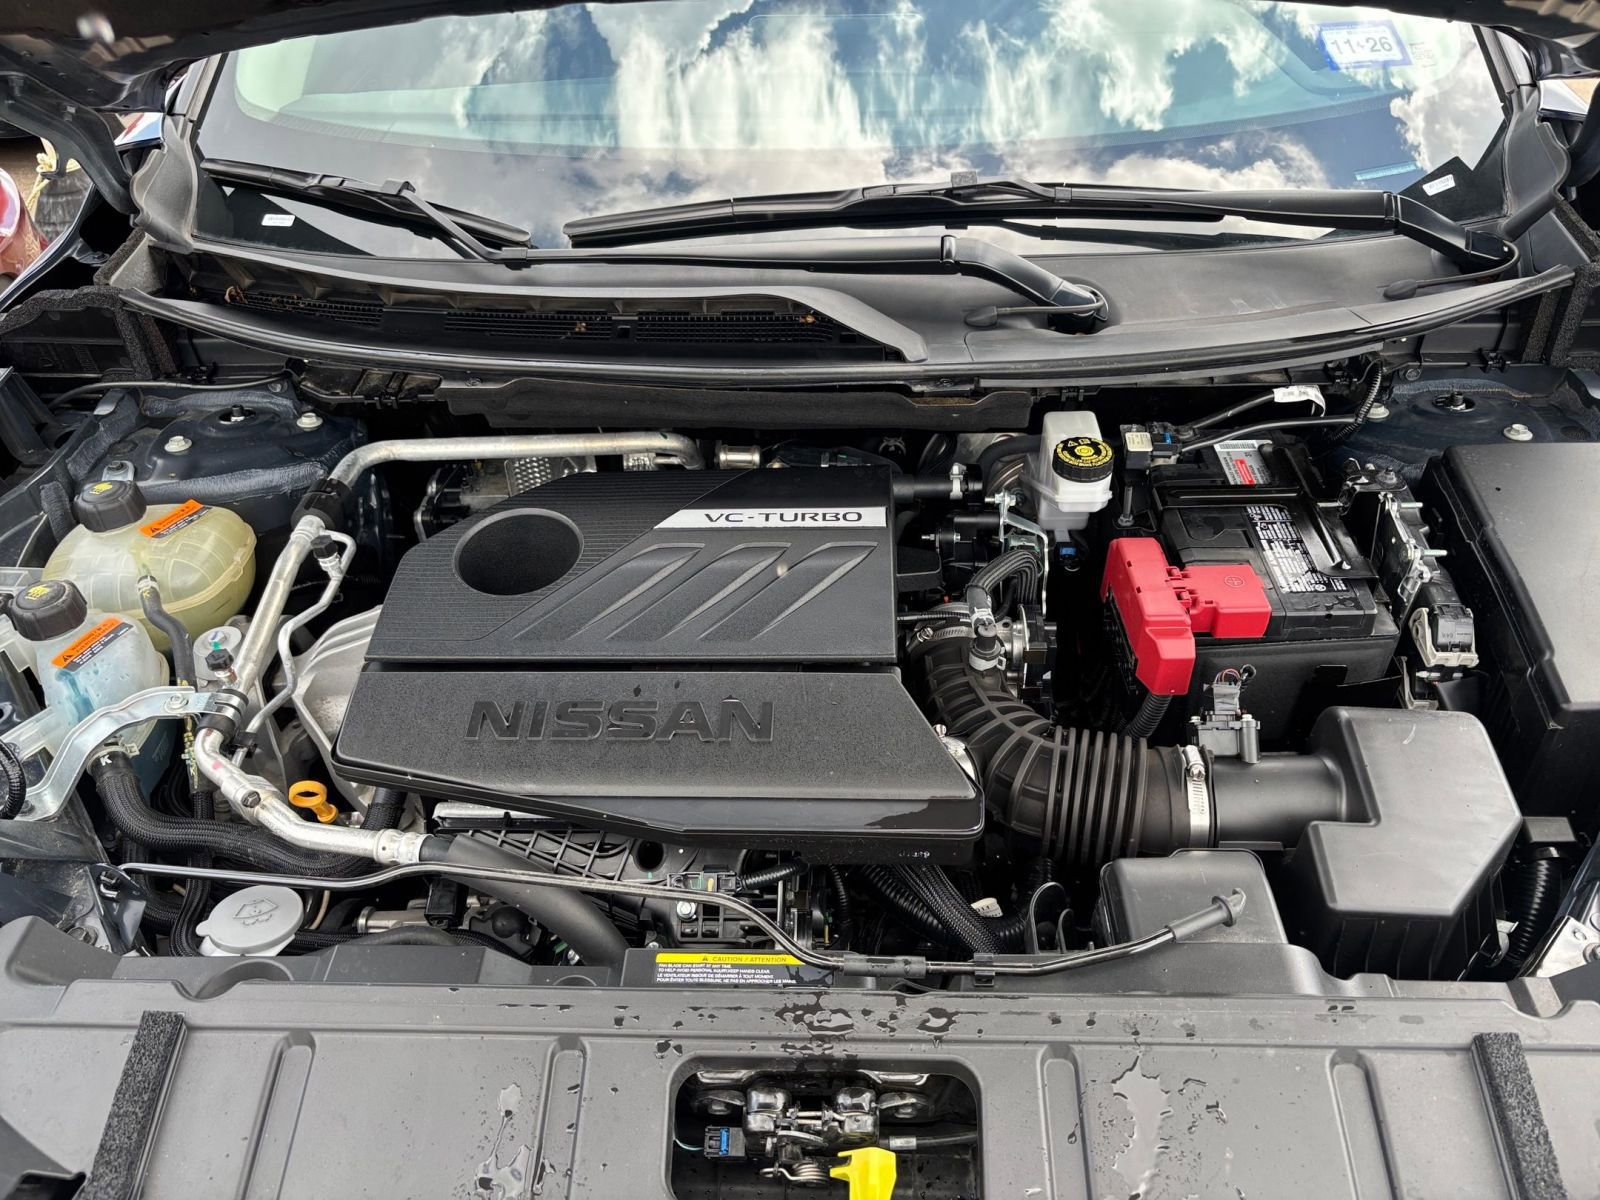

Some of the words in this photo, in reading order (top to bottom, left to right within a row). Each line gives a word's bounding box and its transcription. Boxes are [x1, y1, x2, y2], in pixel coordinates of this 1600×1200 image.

[1366, 36, 1393, 53] 26
[704, 511, 863, 523] VC-TURBO
[464, 700, 775, 742] NISSAN
[100, 755, 112, 766] K
